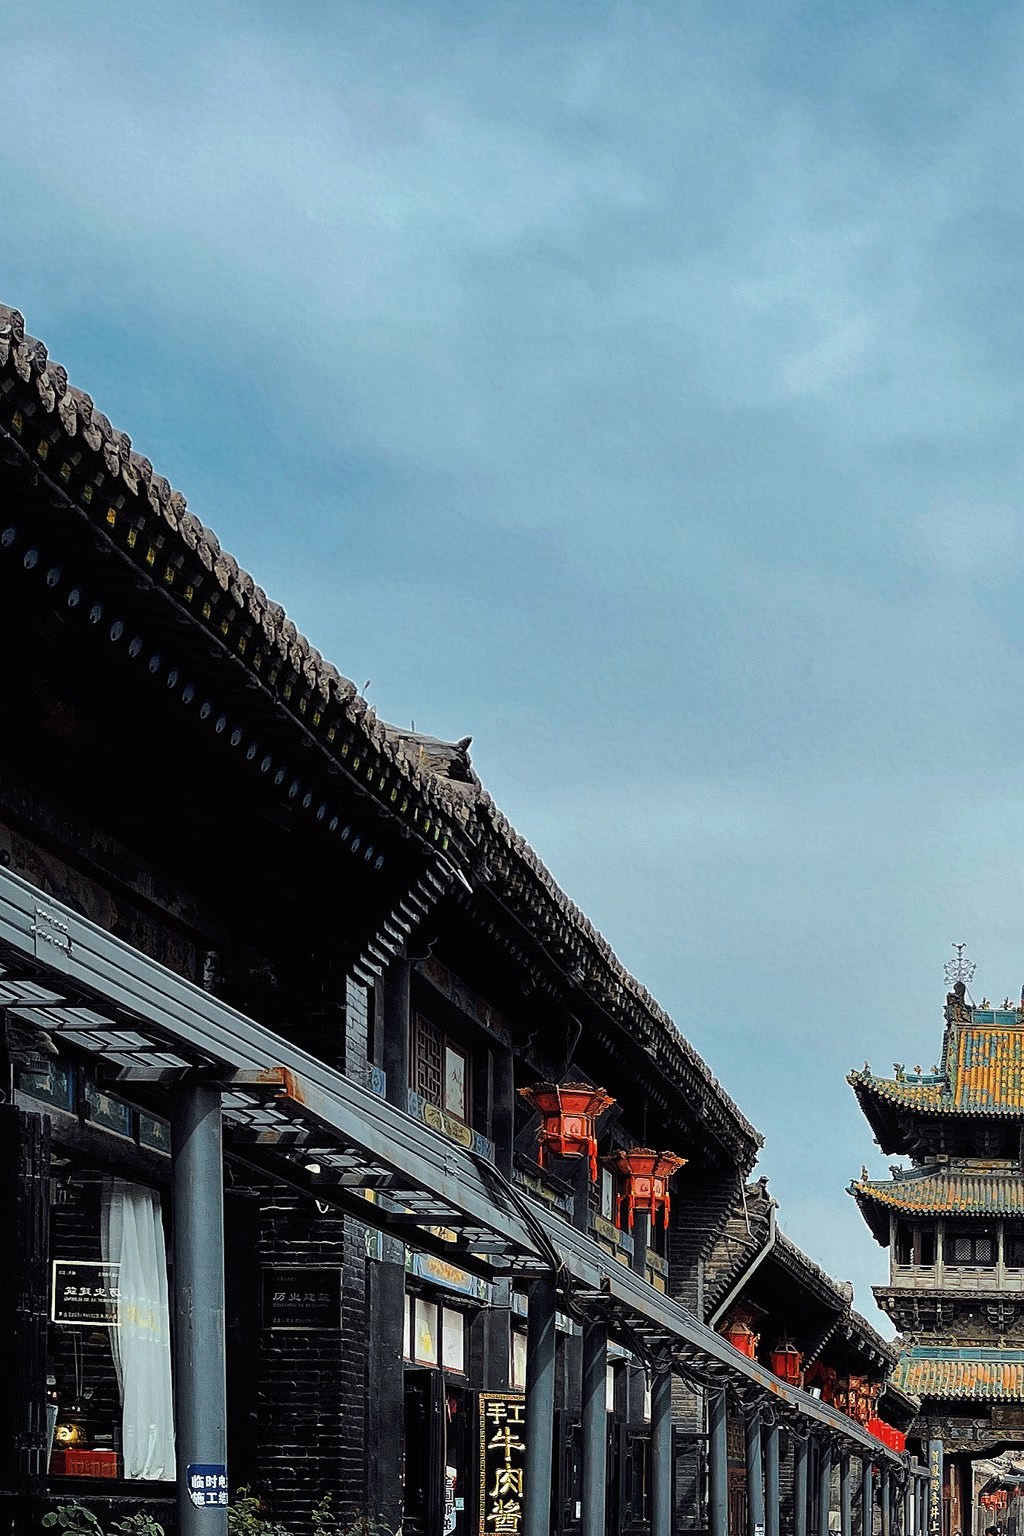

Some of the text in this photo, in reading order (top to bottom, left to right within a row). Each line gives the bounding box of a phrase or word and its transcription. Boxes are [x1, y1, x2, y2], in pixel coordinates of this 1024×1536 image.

[486, 1402, 526, 1425] 手工
[486, 1426, 527, 1533] 牛肉酱
